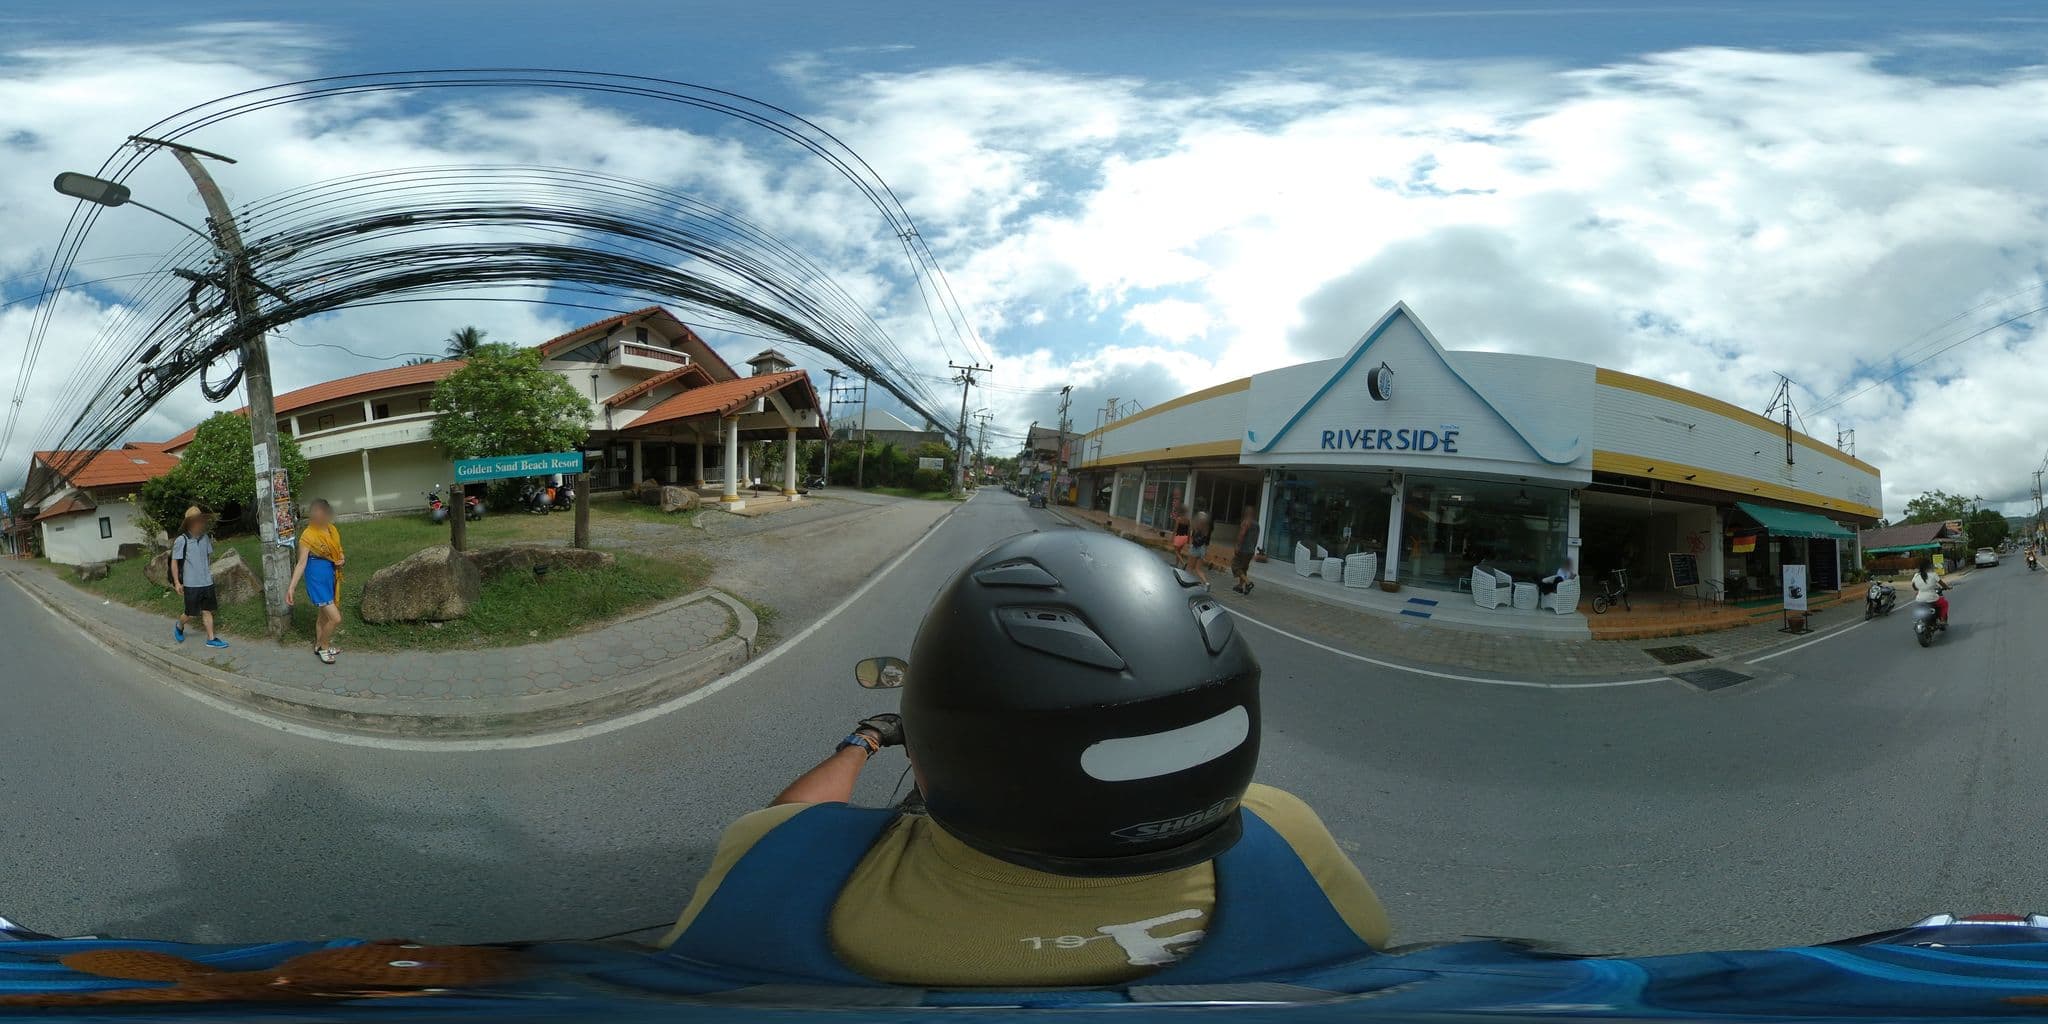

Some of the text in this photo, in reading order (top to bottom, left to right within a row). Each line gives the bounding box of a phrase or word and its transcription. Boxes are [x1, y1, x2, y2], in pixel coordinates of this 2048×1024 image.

[1321, 429, 1459, 453] RIVERSIDE
[458, 458, 579, 476] Golden Sand Beach Resort
